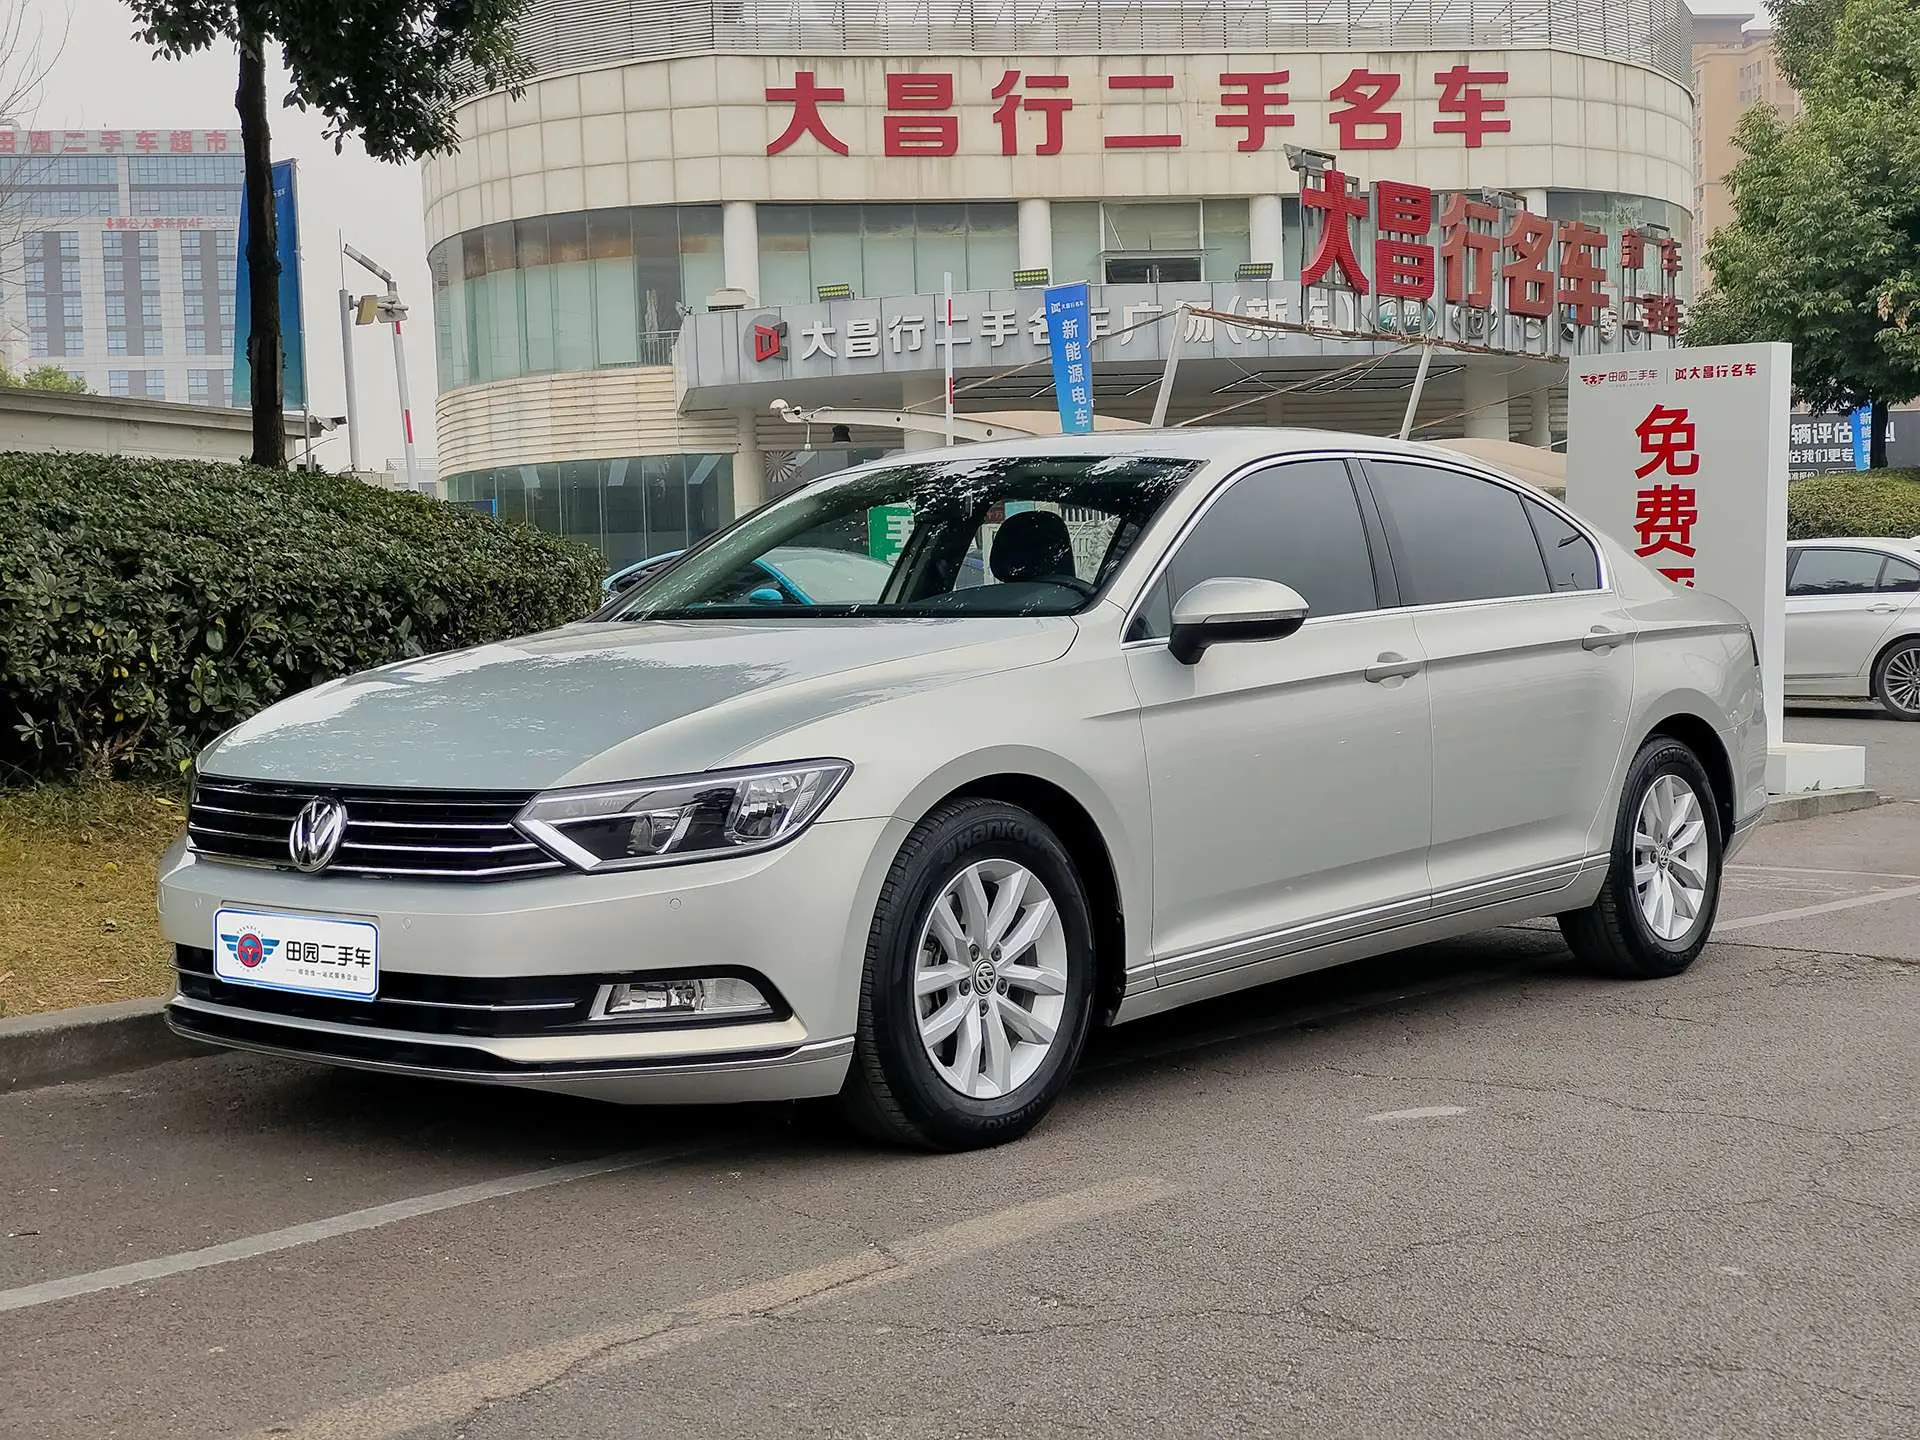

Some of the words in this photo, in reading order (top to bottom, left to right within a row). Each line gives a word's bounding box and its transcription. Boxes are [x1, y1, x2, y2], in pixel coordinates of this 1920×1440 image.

[765, 65, 1511, 158] 大昌行二手名车
[1301, 170, 1610, 329] 大昌行名车
[1061, 318, 1089, 428] 新能源电车
[1608, 369, 1658, 382] 田园二手车
[1689, 363, 1757, 380] 大昌行名车
[1633, 403, 1700, 588] 免费
[286, 940, 371, 969] 田园二手车
